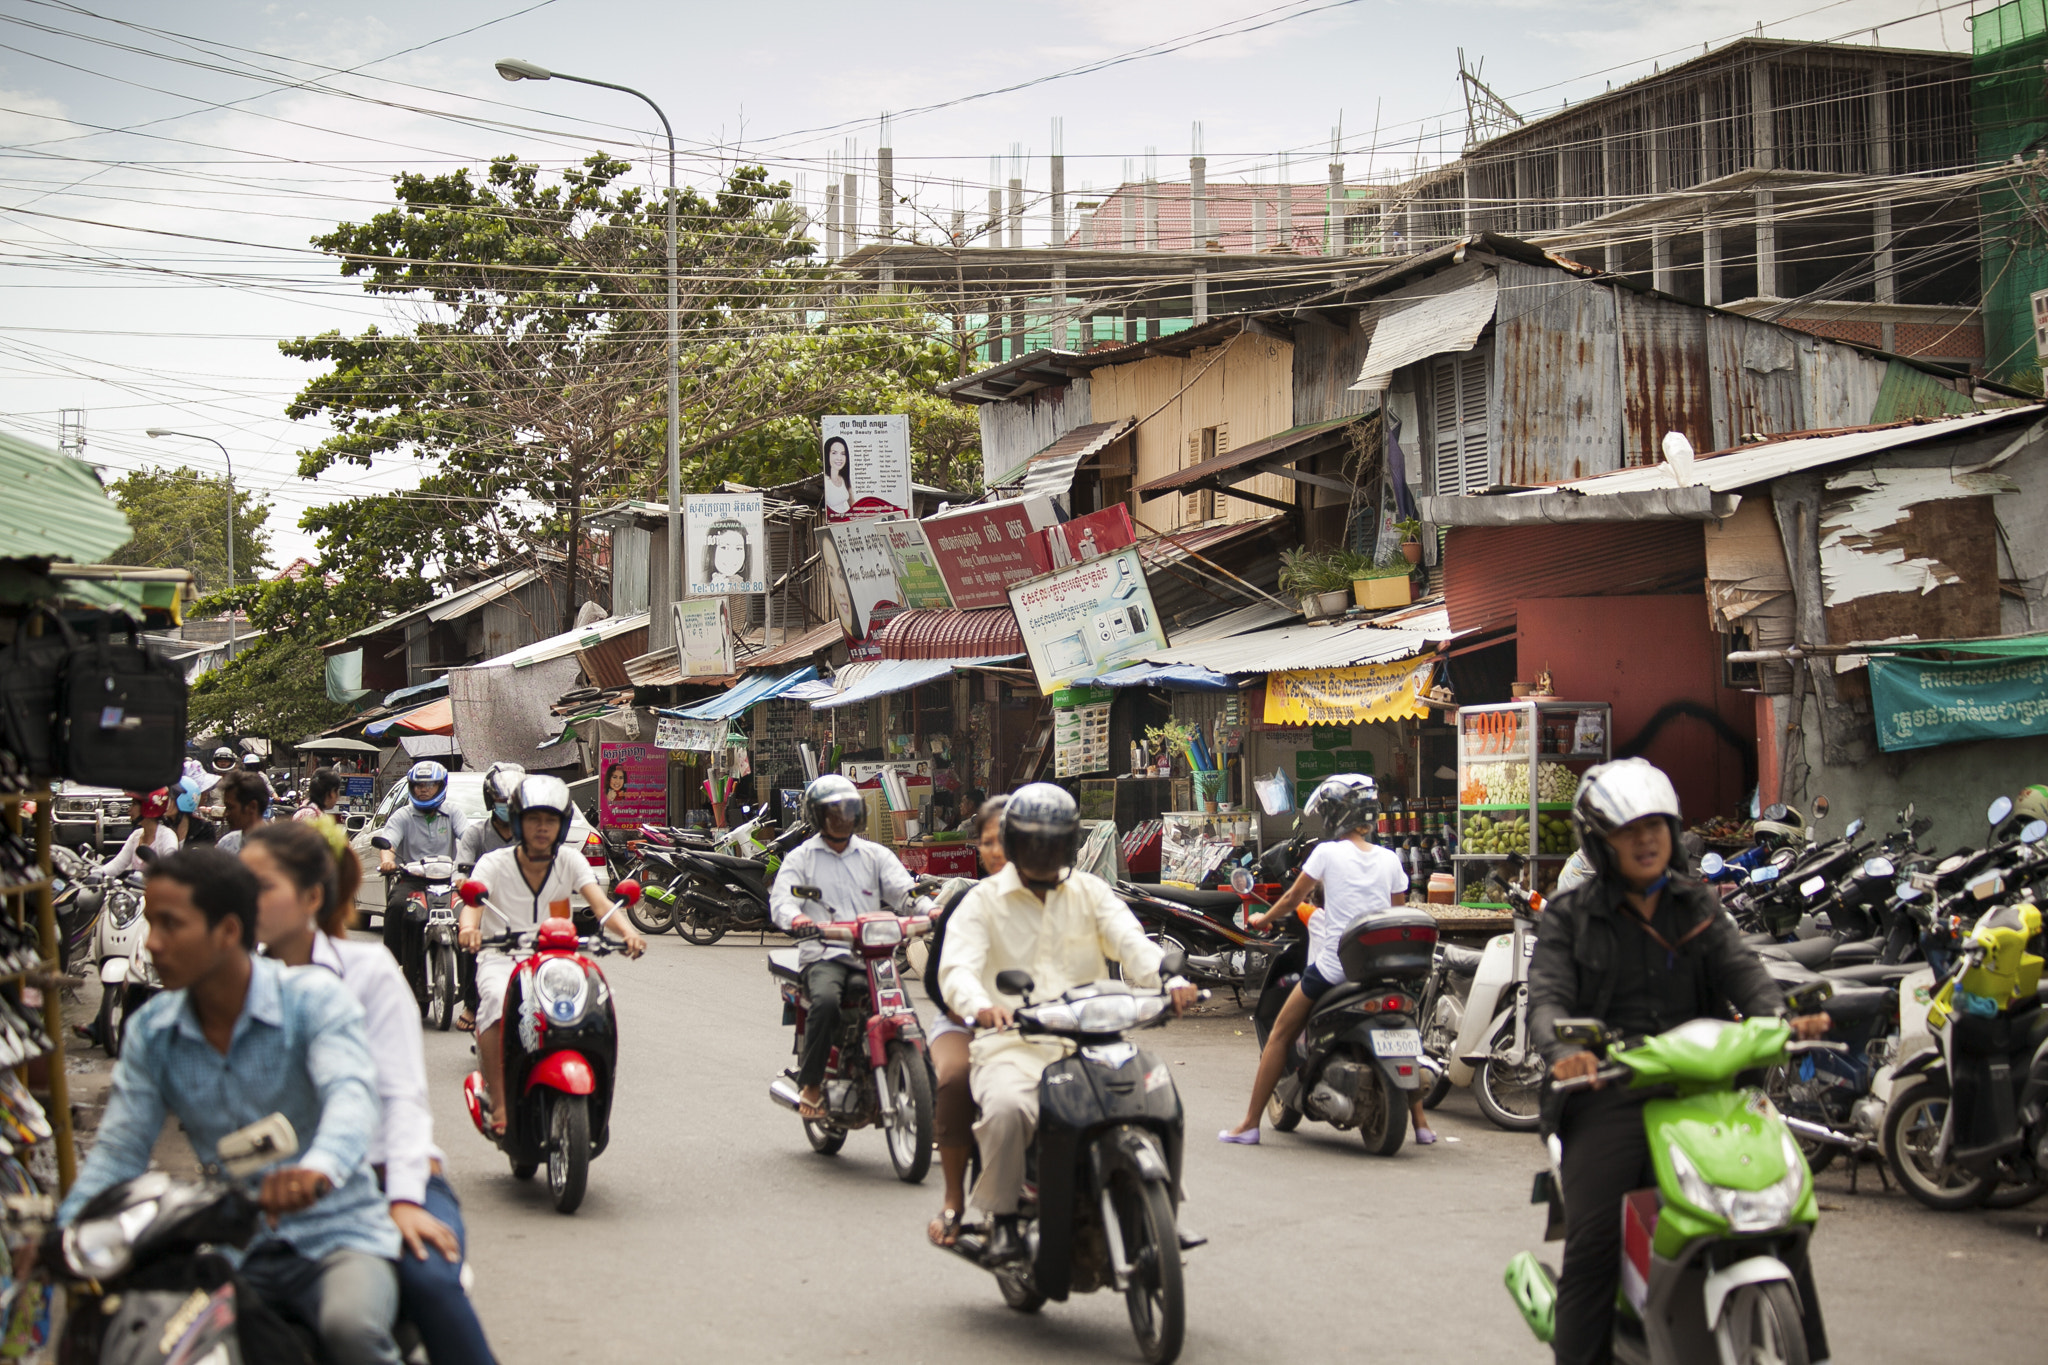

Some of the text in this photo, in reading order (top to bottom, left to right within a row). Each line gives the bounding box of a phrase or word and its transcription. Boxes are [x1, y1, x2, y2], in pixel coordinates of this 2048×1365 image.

[957, 555, 974, 571] Meng
[1000, 553, 1012, 563] Phone
[1012, 552, 1023, 562] Shop
[876, 563, 891, 576] Salon
[692, 581, 763, 593] Tel: 012 71 98 80
[1476, 710, 1518, 754] 999
[1377, 1040, 1418, 1051] 1AX-5007
